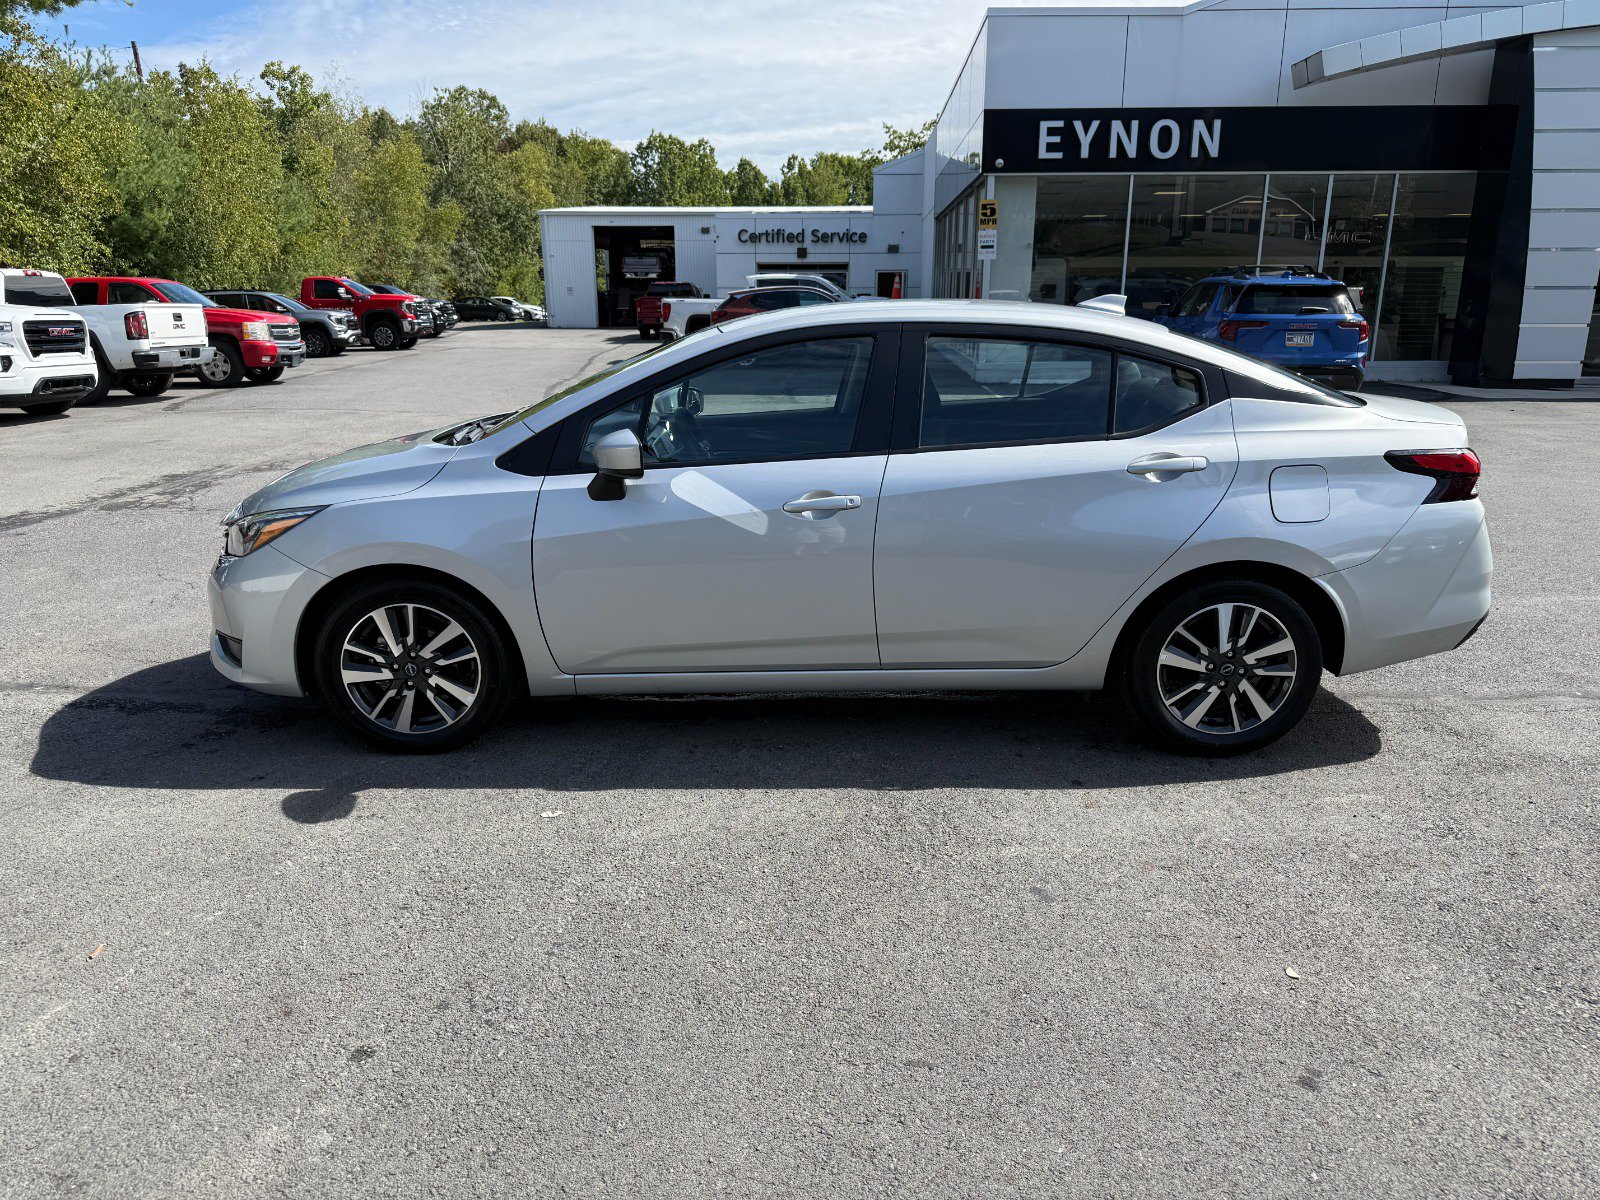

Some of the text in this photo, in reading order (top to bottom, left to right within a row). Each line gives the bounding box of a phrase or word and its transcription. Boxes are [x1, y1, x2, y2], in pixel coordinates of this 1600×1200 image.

[1038, 118, 1222, 160] EYNON
[981, 203, 997, 218] 5
[980, 218, 997, 226] MPH
[738, 228, 868, 243] Certified Service
[48, 327, 76, 337] GMC
